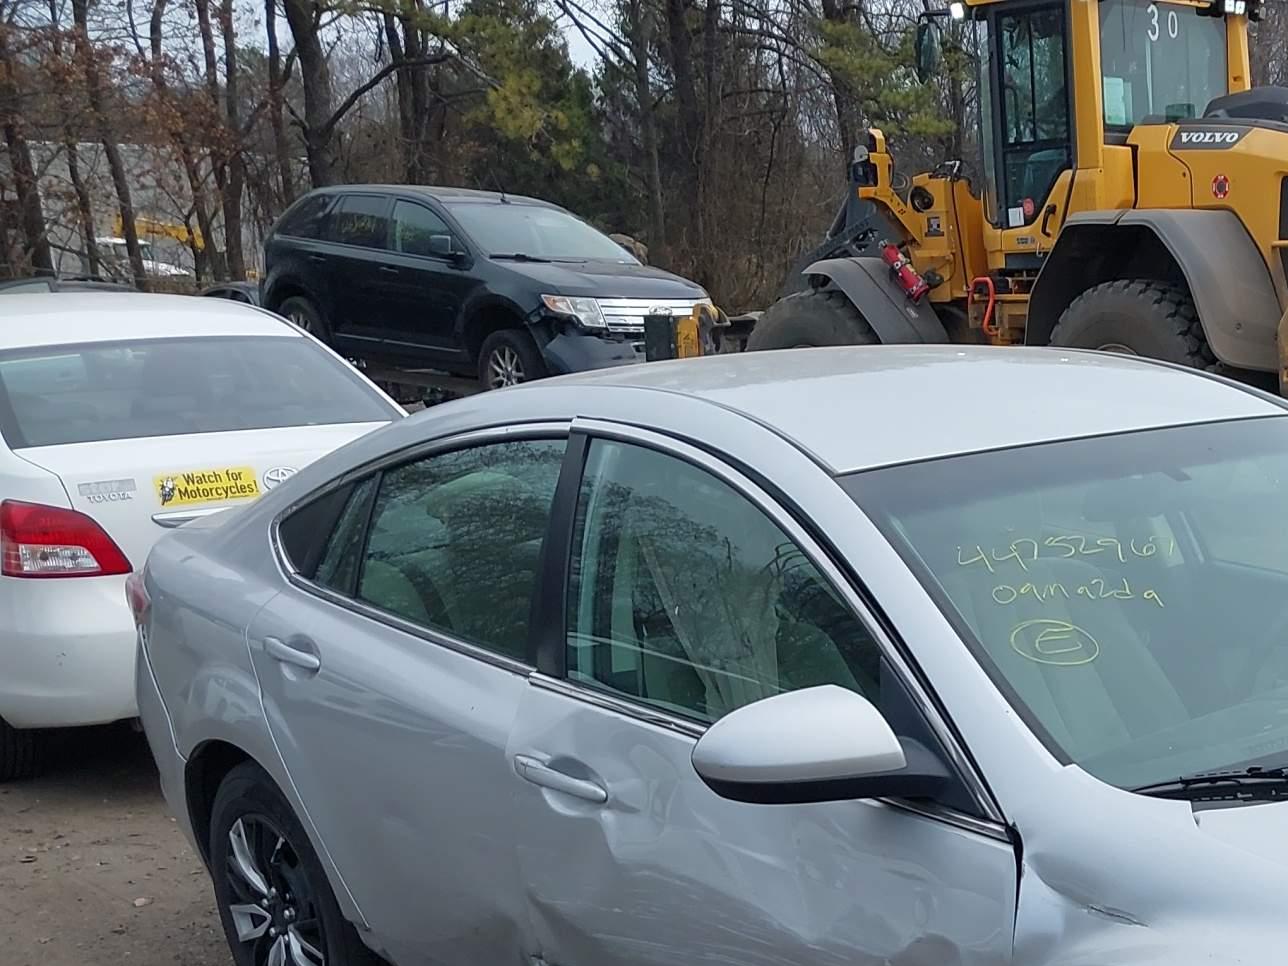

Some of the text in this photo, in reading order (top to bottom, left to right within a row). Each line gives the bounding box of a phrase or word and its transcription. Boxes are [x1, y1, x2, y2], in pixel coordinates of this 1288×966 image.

[1180, 131, 1239, 144] VOLVO
[182, 469, 243, 486] Watch for
[87, 491, 133, 504] TOYOTA
[177, 479, 259, 501] Motorcycles!
